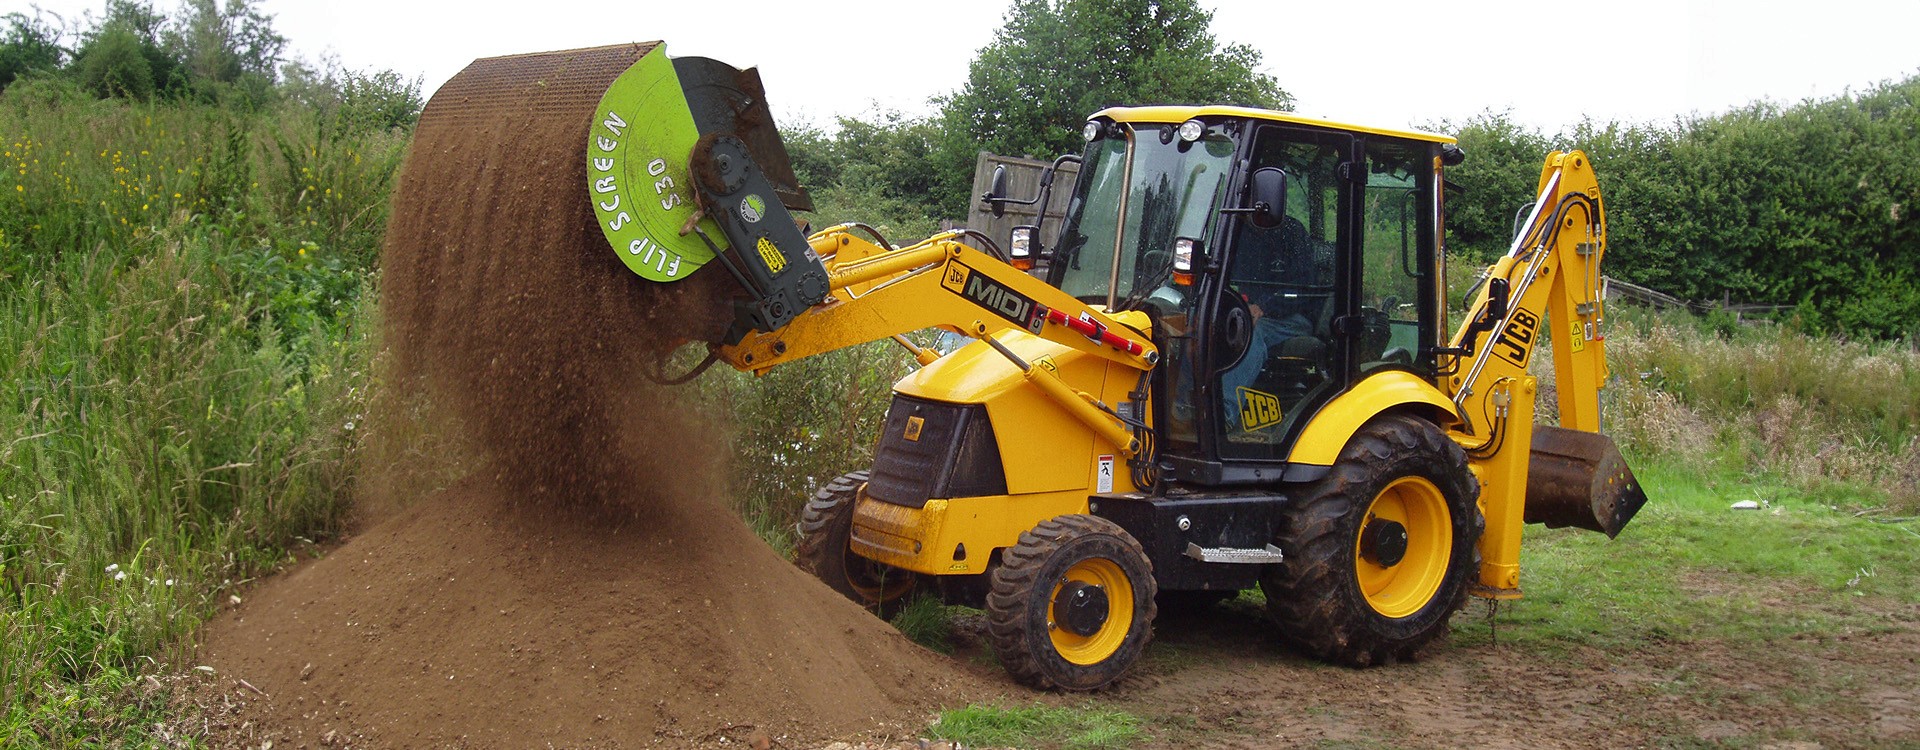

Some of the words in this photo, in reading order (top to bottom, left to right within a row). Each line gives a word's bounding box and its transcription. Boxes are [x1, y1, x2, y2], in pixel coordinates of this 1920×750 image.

[593, 110, 631, 231] SCREEN
[647, 157, 681, 211] S30
[629, 237, 682, 277] FLIP
[950, 268, 963, 283] JCB
[967, 275, 1030, 322] MIDI
[1495, 312, 1535, 362] JCB
[1244, 391, 1279, 427] JCB
